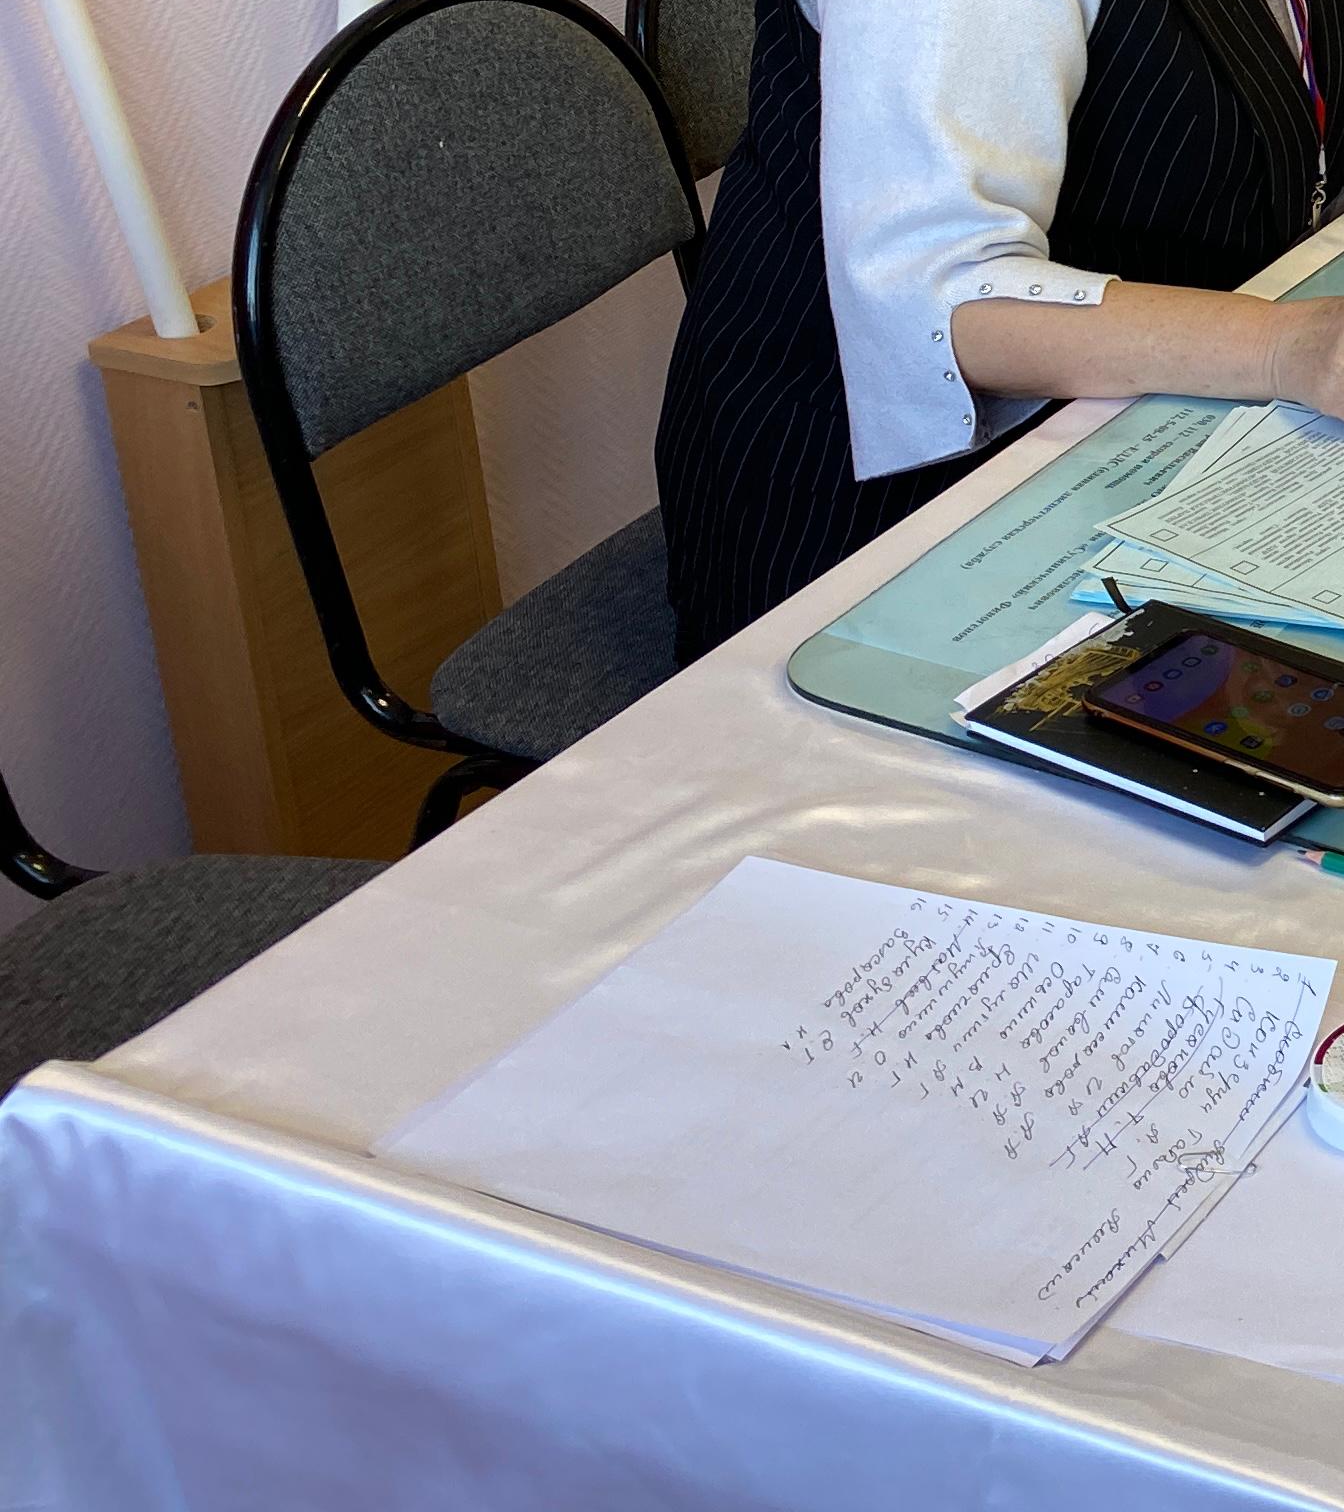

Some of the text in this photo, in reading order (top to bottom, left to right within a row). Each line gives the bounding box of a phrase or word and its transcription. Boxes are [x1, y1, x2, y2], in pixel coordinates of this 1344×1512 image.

[1141, 442, 1173, 464] скорая
[1071, 467, 1109, 490] (единая
[1001, 491, 1072, 540] диспетчерская
[960, 541, 1002, 569] служба)
[911, 898, 927, 910] 16
[1014, 918, 1029, 932] 12
[1068, 928, 1081, 944] 10
[1093, 933, 1108, 945] 9
[1272, 967, 1289, 982] 2
[1021, 964, 1095, 1049] Тарасова
